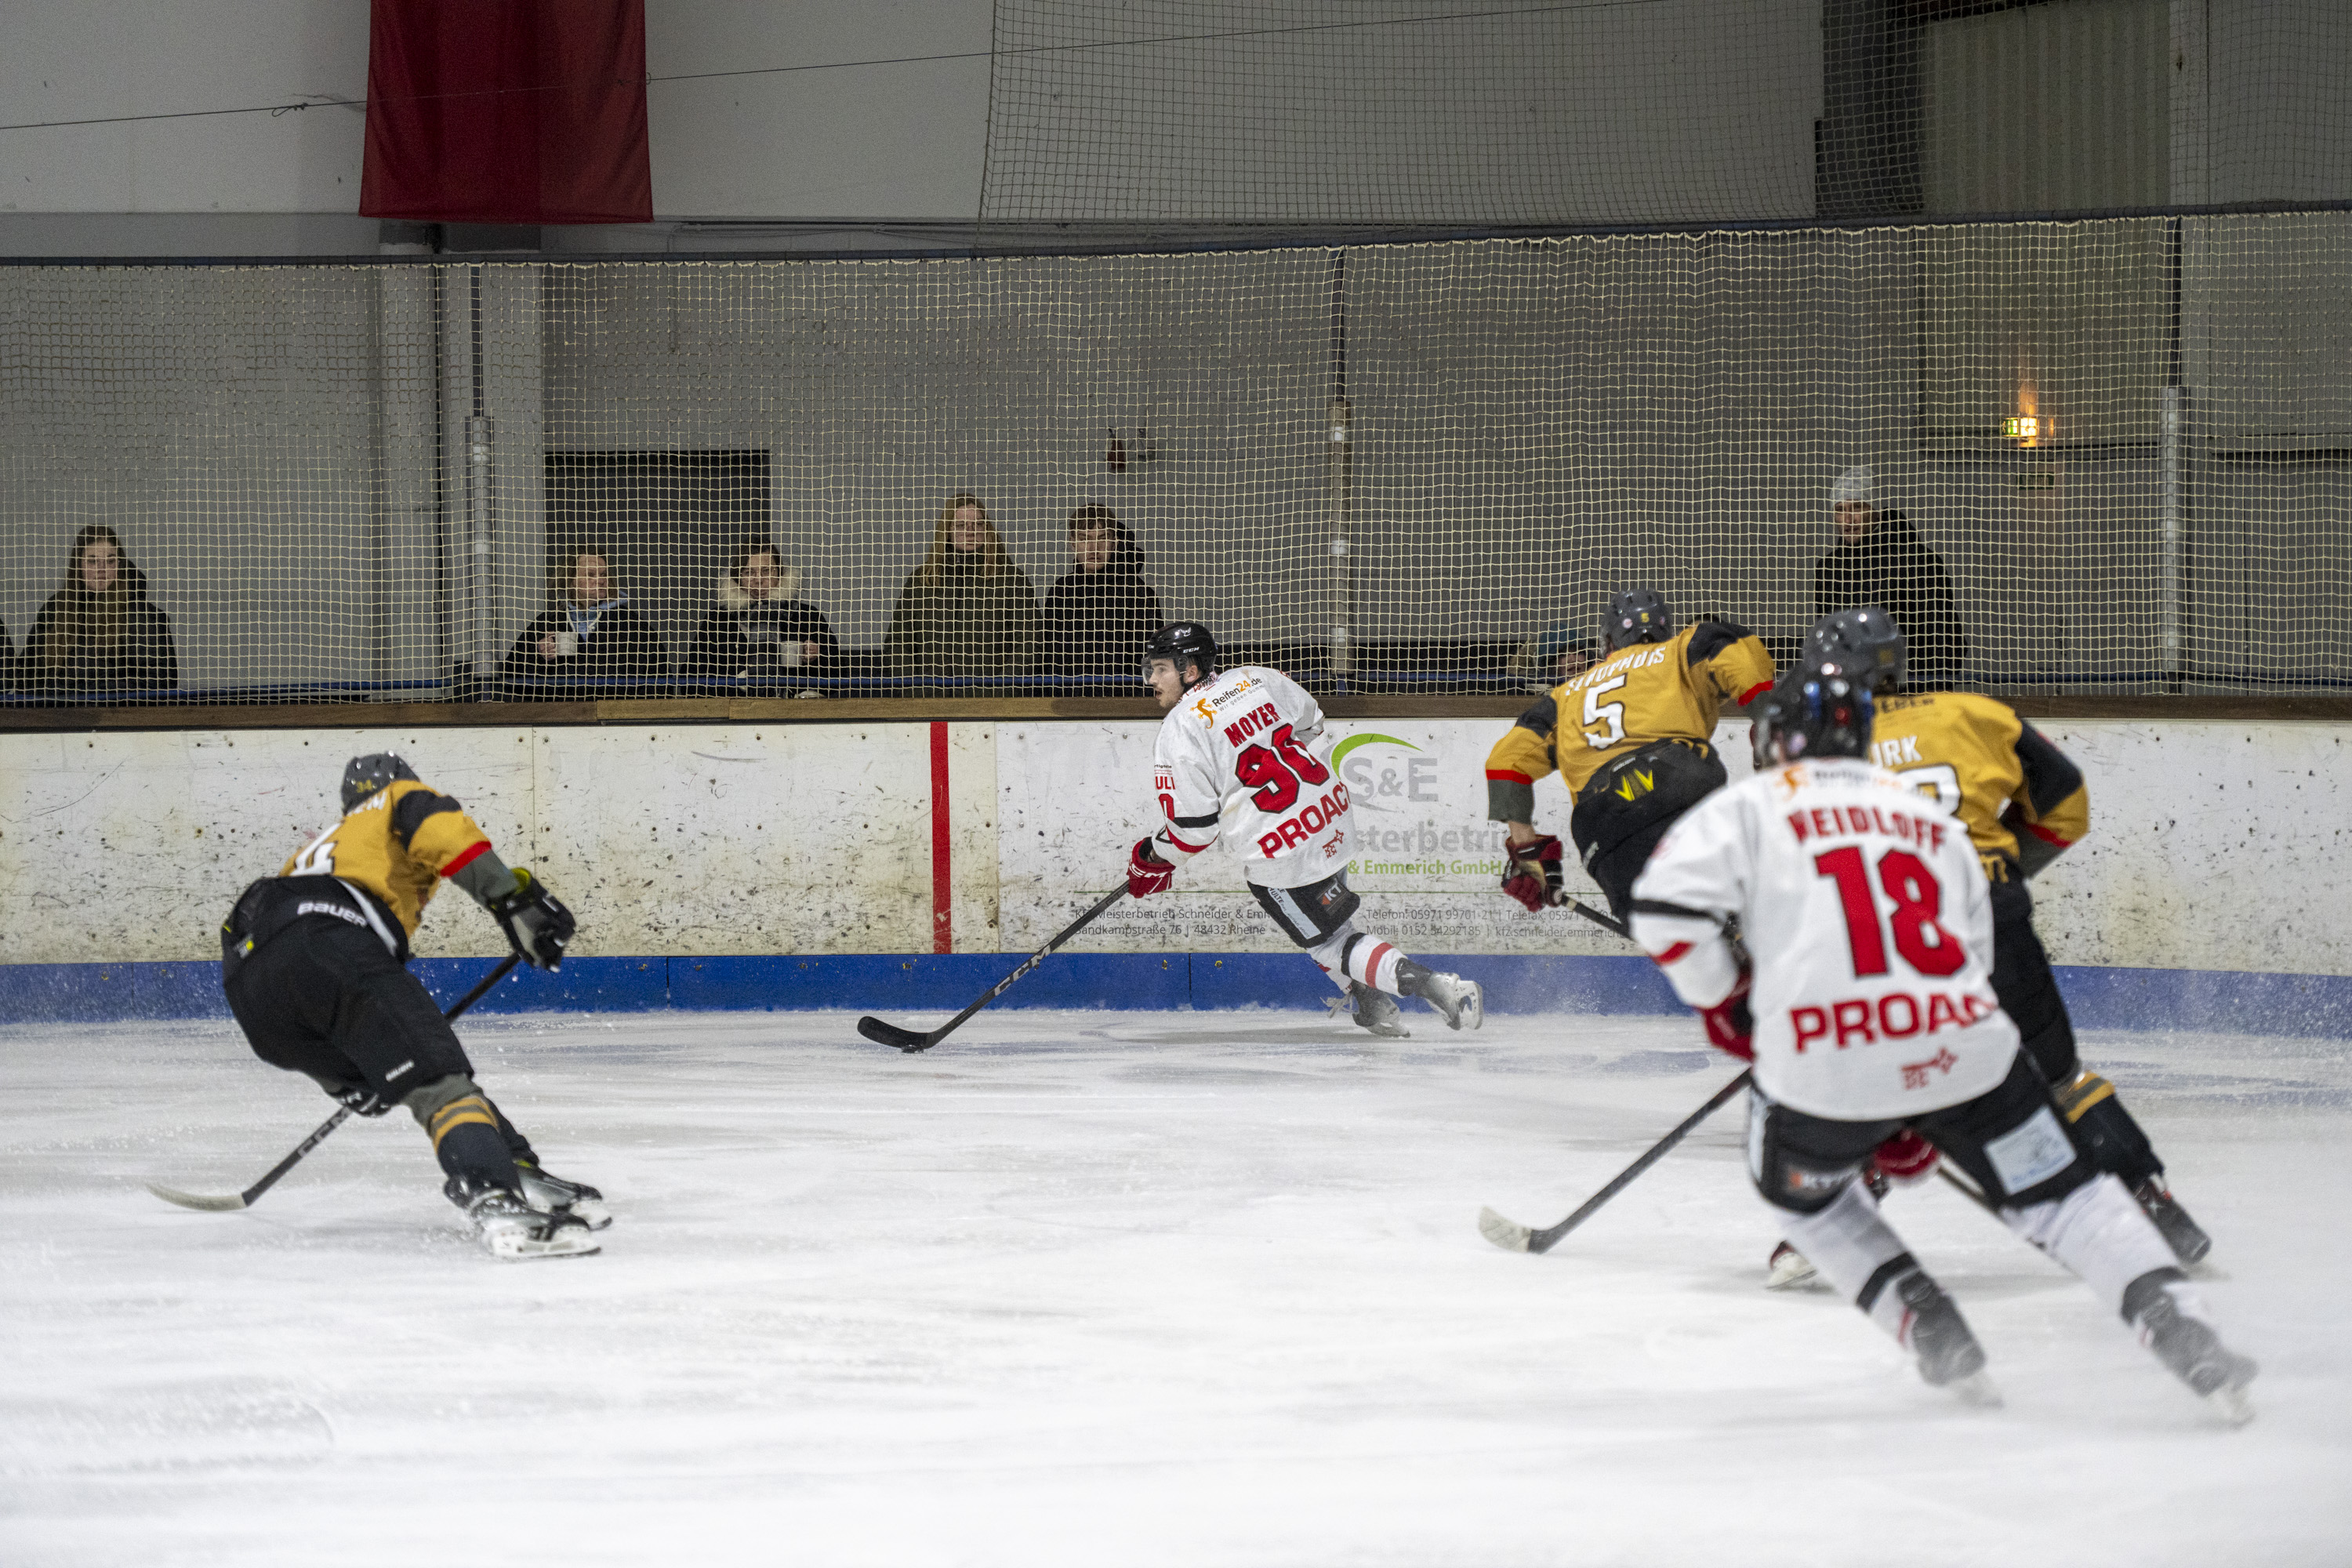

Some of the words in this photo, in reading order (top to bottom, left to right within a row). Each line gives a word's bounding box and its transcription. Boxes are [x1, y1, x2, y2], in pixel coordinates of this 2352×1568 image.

[1212, 677, 1262, 707] Reifen24.de
[1230, 693, 1247, 706] geben
[1224, 702, 1281, 748] MOYER
[1583, 673, 1628, 750] 5
[1235, 723, 1330, 814] 90
[1356, 821, 1508, 853] sterbetri
[1348, 860, 1359, 875] &
[1364, 859, 1446, 875] Emmerich
[1450, 859, 1502, 875] GmbH
[1178, 909, 1232, 919] Schneider
[1236, 909, 1243, 919] &
[1367, 909, 1408, 920] Telefon:
[1412, 909, 1442, 920] 05971
[1549, 910, 1579, 920] 05971
[1813, 845, 1969, 978] 18
[1169, 925, 1182, 935] 76
[1194, 925, 1226, 935] 48432
[1230, 925, 1265, 935] Rheine
[1367, 925, 1399, 935] Mobil:
[1402, 926, 1426, 935] 0152
[994, 945, 1051, 996] CCM
